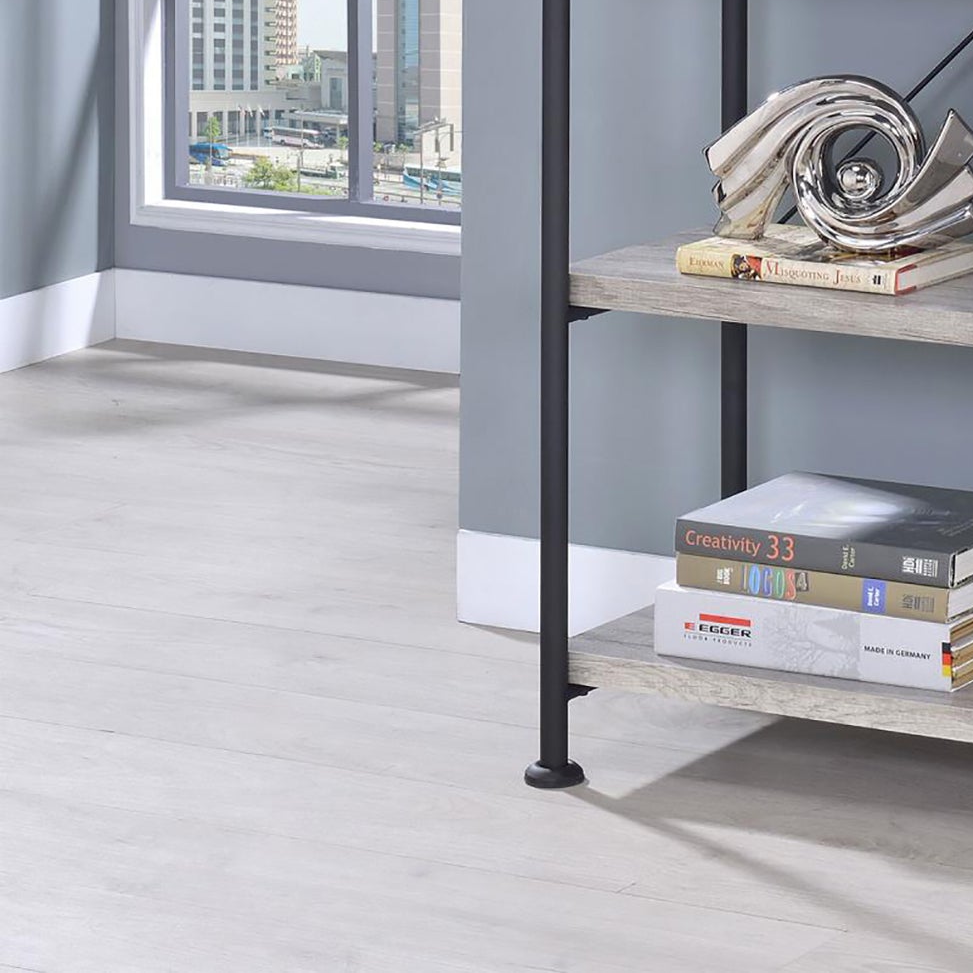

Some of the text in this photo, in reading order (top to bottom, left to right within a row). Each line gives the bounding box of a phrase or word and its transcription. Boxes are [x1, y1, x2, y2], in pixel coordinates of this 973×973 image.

[685, 530, 796, 562] Creativity 33
[698, 623, 752, 639] EGGER
[864, 645, 931, 660] MADE IN GERMANY
